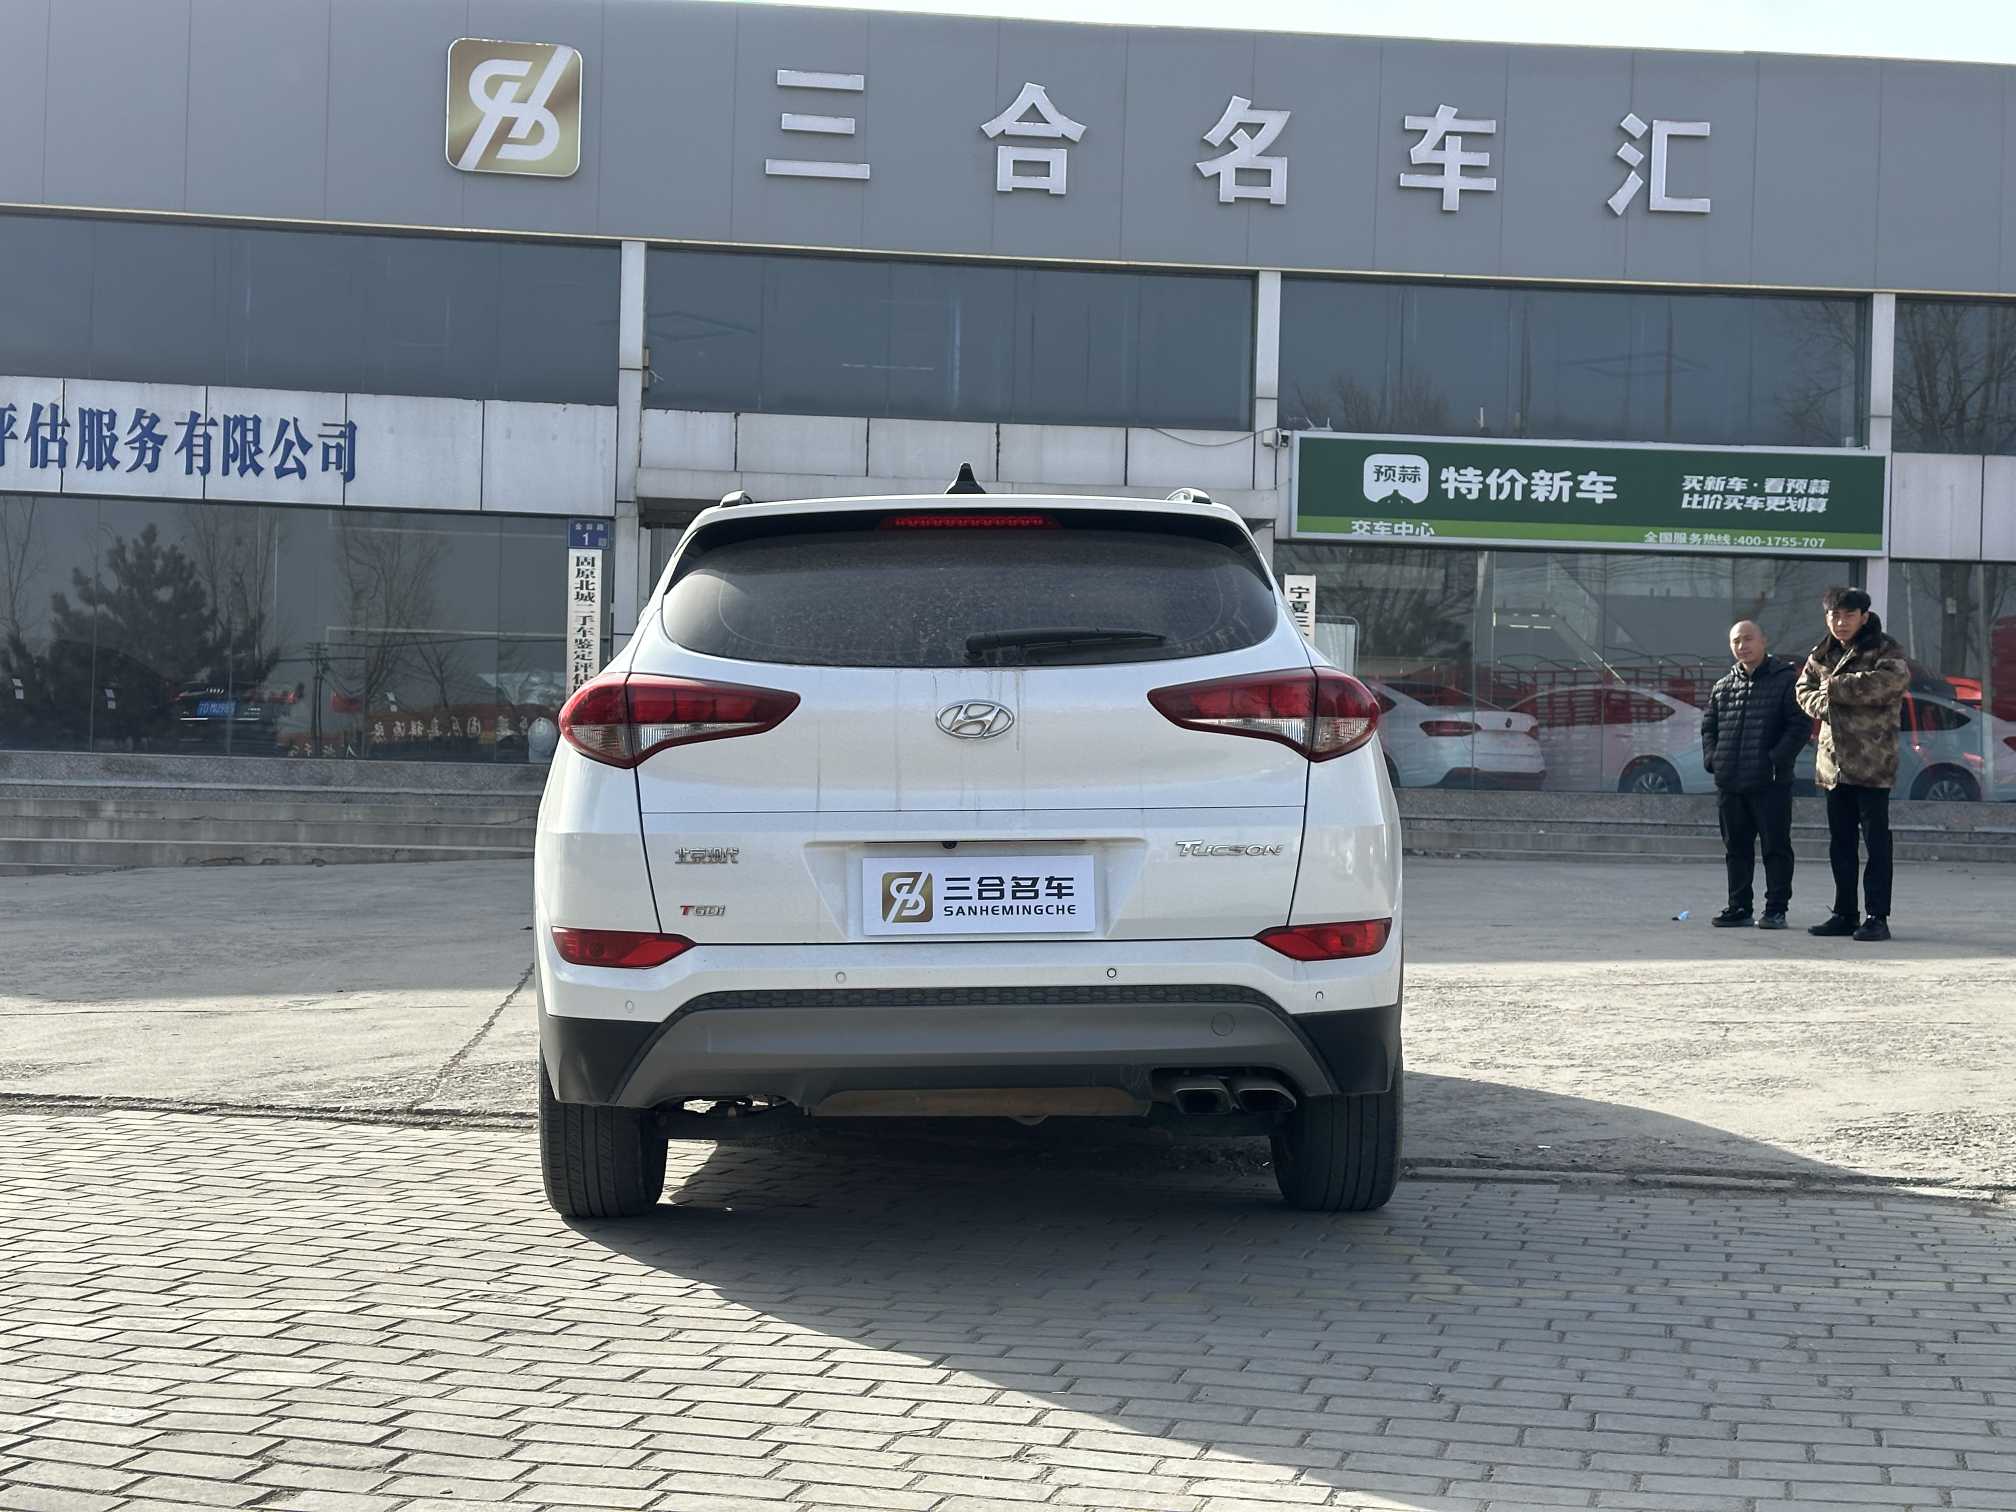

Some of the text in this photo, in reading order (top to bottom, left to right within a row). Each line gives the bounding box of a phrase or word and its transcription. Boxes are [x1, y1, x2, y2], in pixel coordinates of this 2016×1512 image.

[765, 69, 1711, 216] 三合名车汇
[1373, 464, 1422, 484] 预蒜
[1440, 466, 1618, 504] 特价新车
[1681, 493, 1829, 513] 比价买车更划算
[1351, 519, 1435, 536] 交车中心
[1289, 586, 1310, 637] 宁夏三
[573, 556, 596, 692] 固原北城二手车鉴定评估
[1176, 839, 1284, 857] TUCSON
[943, 876, 1075, 900] 三合名车
[943, 904, 1077, 916] SANHEMINGCHE
